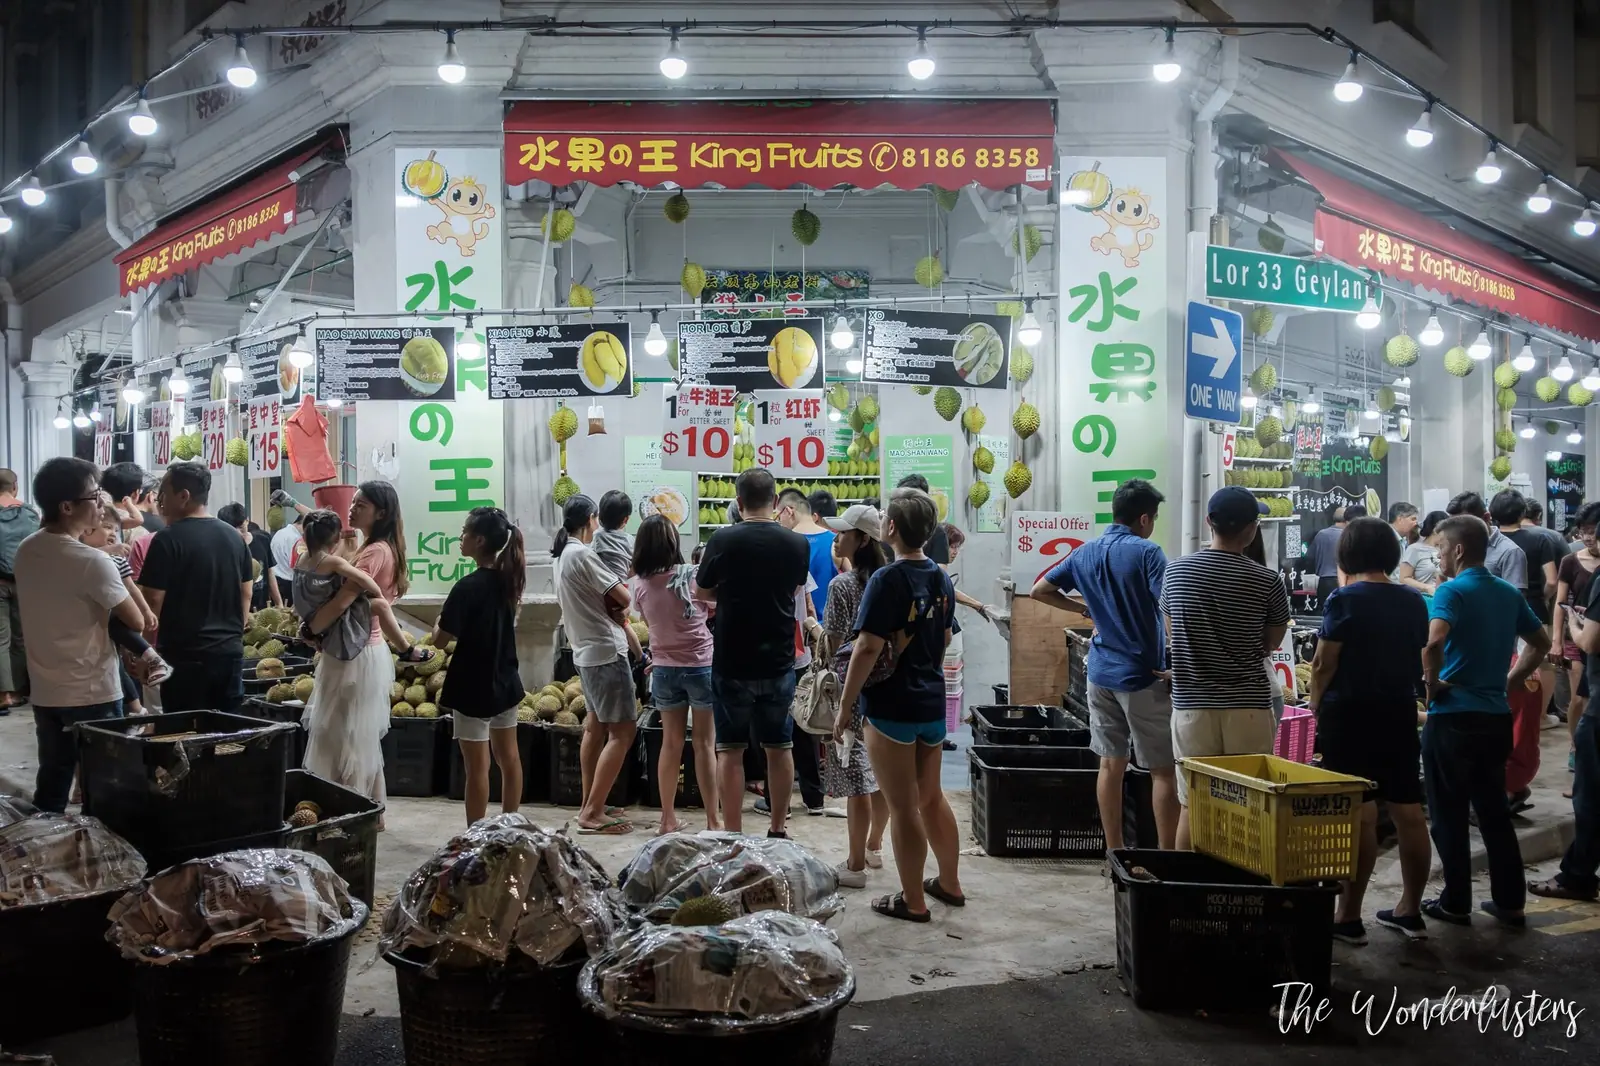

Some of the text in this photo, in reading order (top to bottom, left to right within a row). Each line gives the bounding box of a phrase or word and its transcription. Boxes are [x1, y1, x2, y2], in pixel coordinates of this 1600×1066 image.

[518, 136, 678, 173] 水果の王
[690, 141, 1040, 174] King Fruits 8186 8358
[172, 201, 280, 263] King Fruits 8186 8358
[1358, 228, 1416, 272] 水果の王
[126, 246, 169, 286] 水果の王
[1212, 253, 1250, 286] Lor
[1257, 261, 1282, 290] 33
[1419, 251, 1516, 301] King Fruits 8186 8358
[868, 311, 884, 320] XO
[317, 330, 339, 339] MAO
[341, 330, 368, 339] SHAN
[370, 330, 400, 339] WANG
[489, 329, 509, 338] XIAO
[510, 328, 533, 337] FENG
[681, 324, 704, 333] HOR
[706, 323, 728, 333] LOR
[666, 395, 677, 418] 1
[689, 388, 735, 407] 牛油王
[1190, 383, 1237, 412] ONE WAY
[678, 408, 689, 417] For
[690, 417, 710, 425] BITTER
[757, 400, 768, 425] 1
[786, 398, 821, 419] 红虾
[770, 417, 781, 425] For
[662, 426, 730, 458] $10
[806, 428, 825, 436] SWEET
[757, 437, 825, 468] $10
[1331, 454, 1353, 475] King
[1354, 455, 1381, 475] Fruits
[1018, 516, 1057, 532] Special
[1060, 517, 1089, 530] Offer
[418, 532, 461, 555] Kin
[407, 558, 476, 582] Fruit
[1270, 653, 1291, 662] EED
